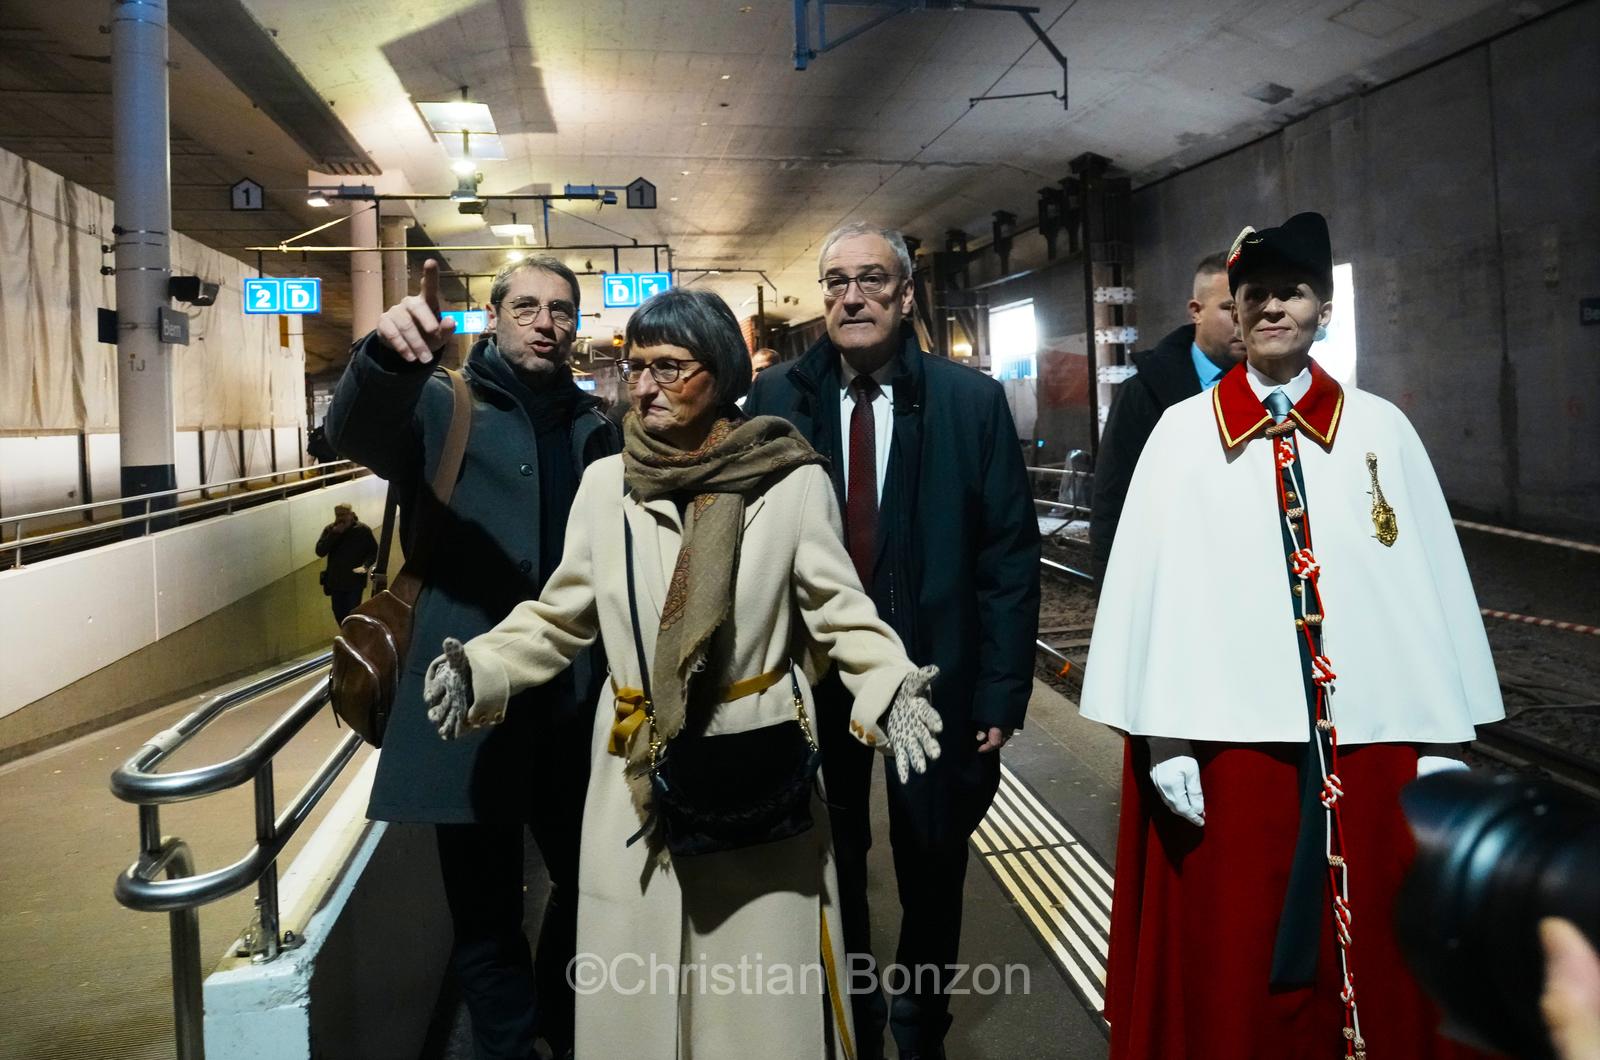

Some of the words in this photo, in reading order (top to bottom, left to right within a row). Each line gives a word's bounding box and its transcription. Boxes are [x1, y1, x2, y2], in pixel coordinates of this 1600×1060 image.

[242, 187, 250, 206] 1
[635, 185, 645, 205] 1
[255, 289, 271, 308] 2
[292, 289, 310, 308] D
[613, 284, 629, 302] D
